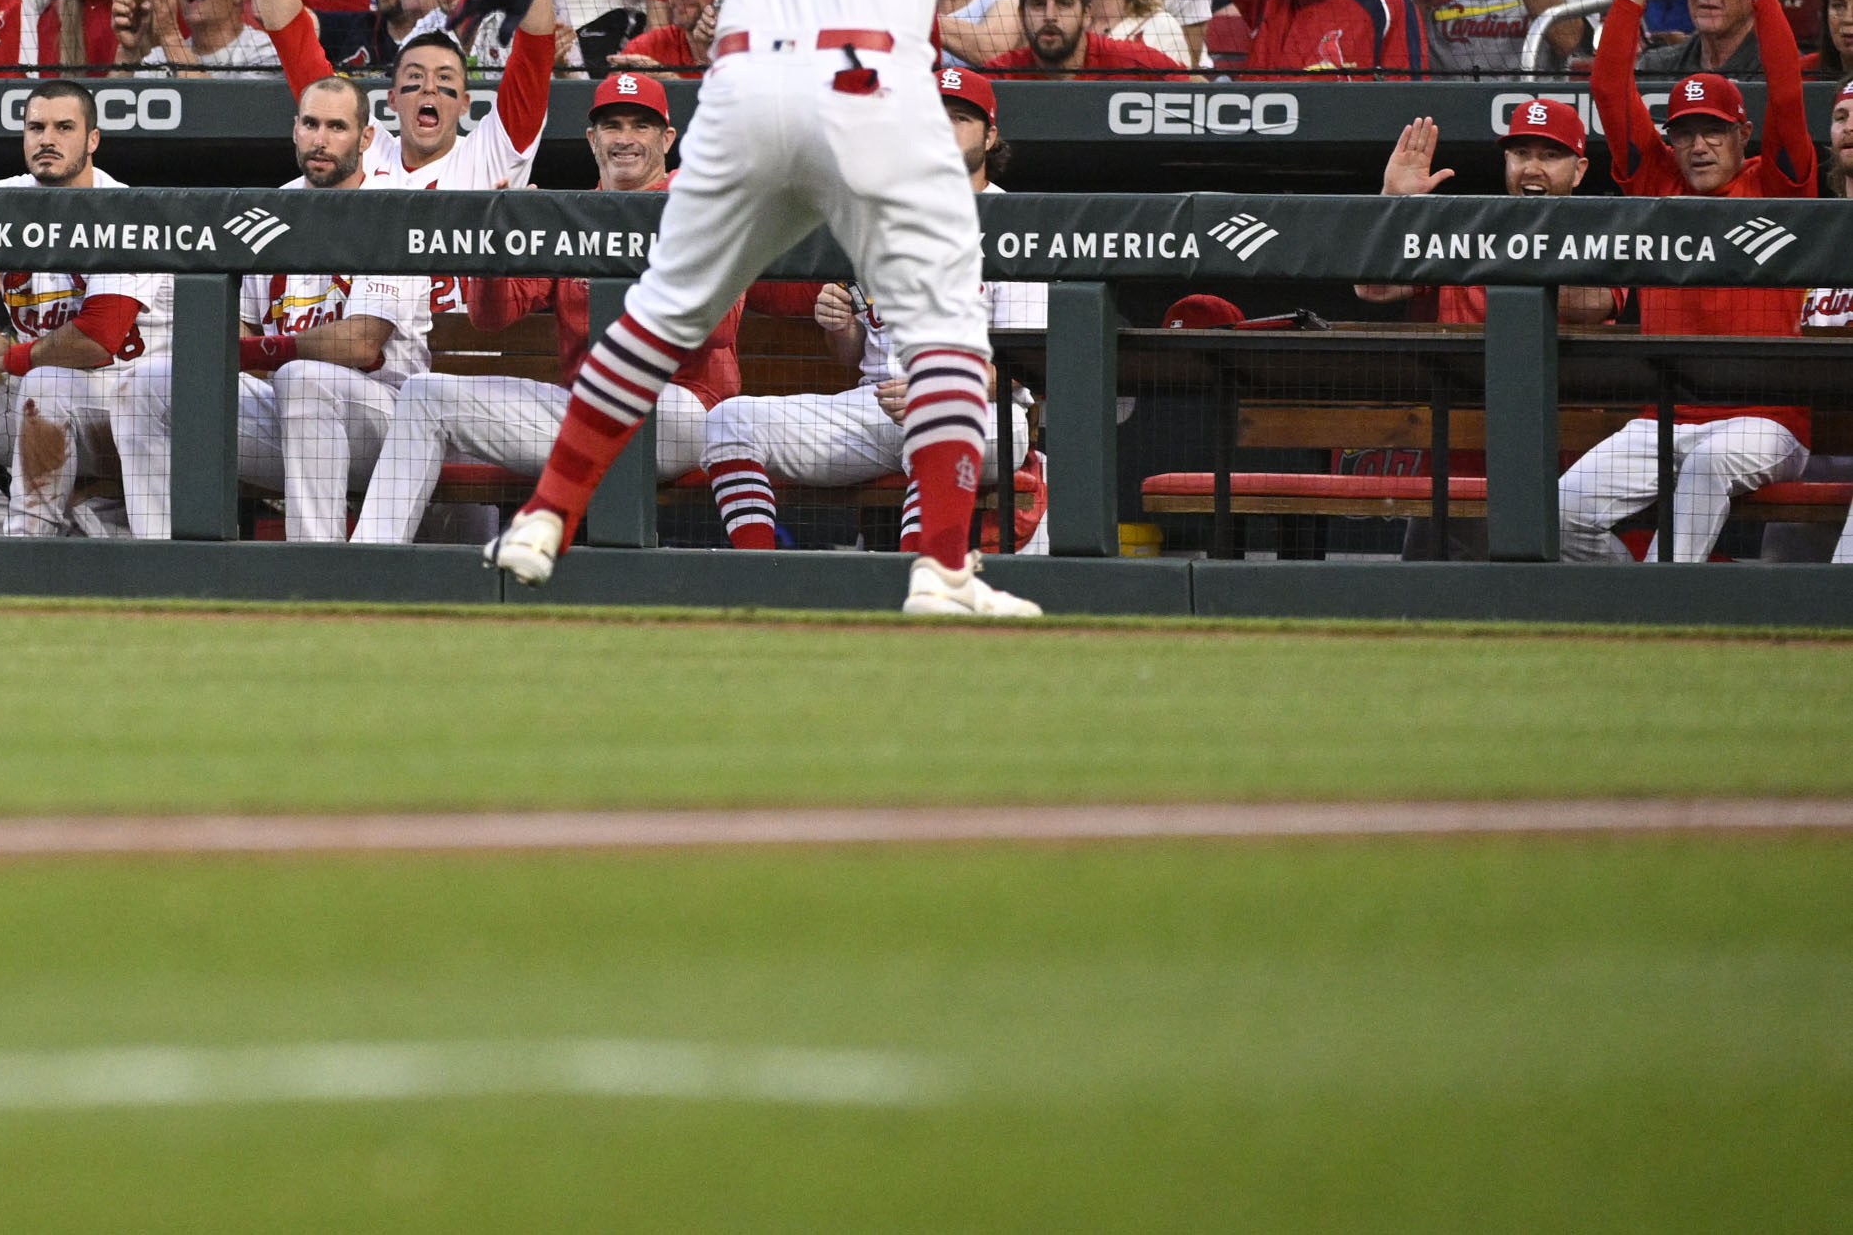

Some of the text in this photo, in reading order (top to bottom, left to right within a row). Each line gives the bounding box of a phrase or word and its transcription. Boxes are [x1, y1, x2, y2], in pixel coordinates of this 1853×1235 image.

[1108, 92, 1300, 135] GEICO
[23, 223, 62, 248] OF
[70, 224, 217, 251] AMERICA
[409, 229, 497, 255] BANK
[505, 230, 547, 256] OF
[998, 233, 1040, 259] OF
[1048, 233, 1200, 259] AMERICA
[1404, 234, 1716, 262] BANK OF AMERICA
